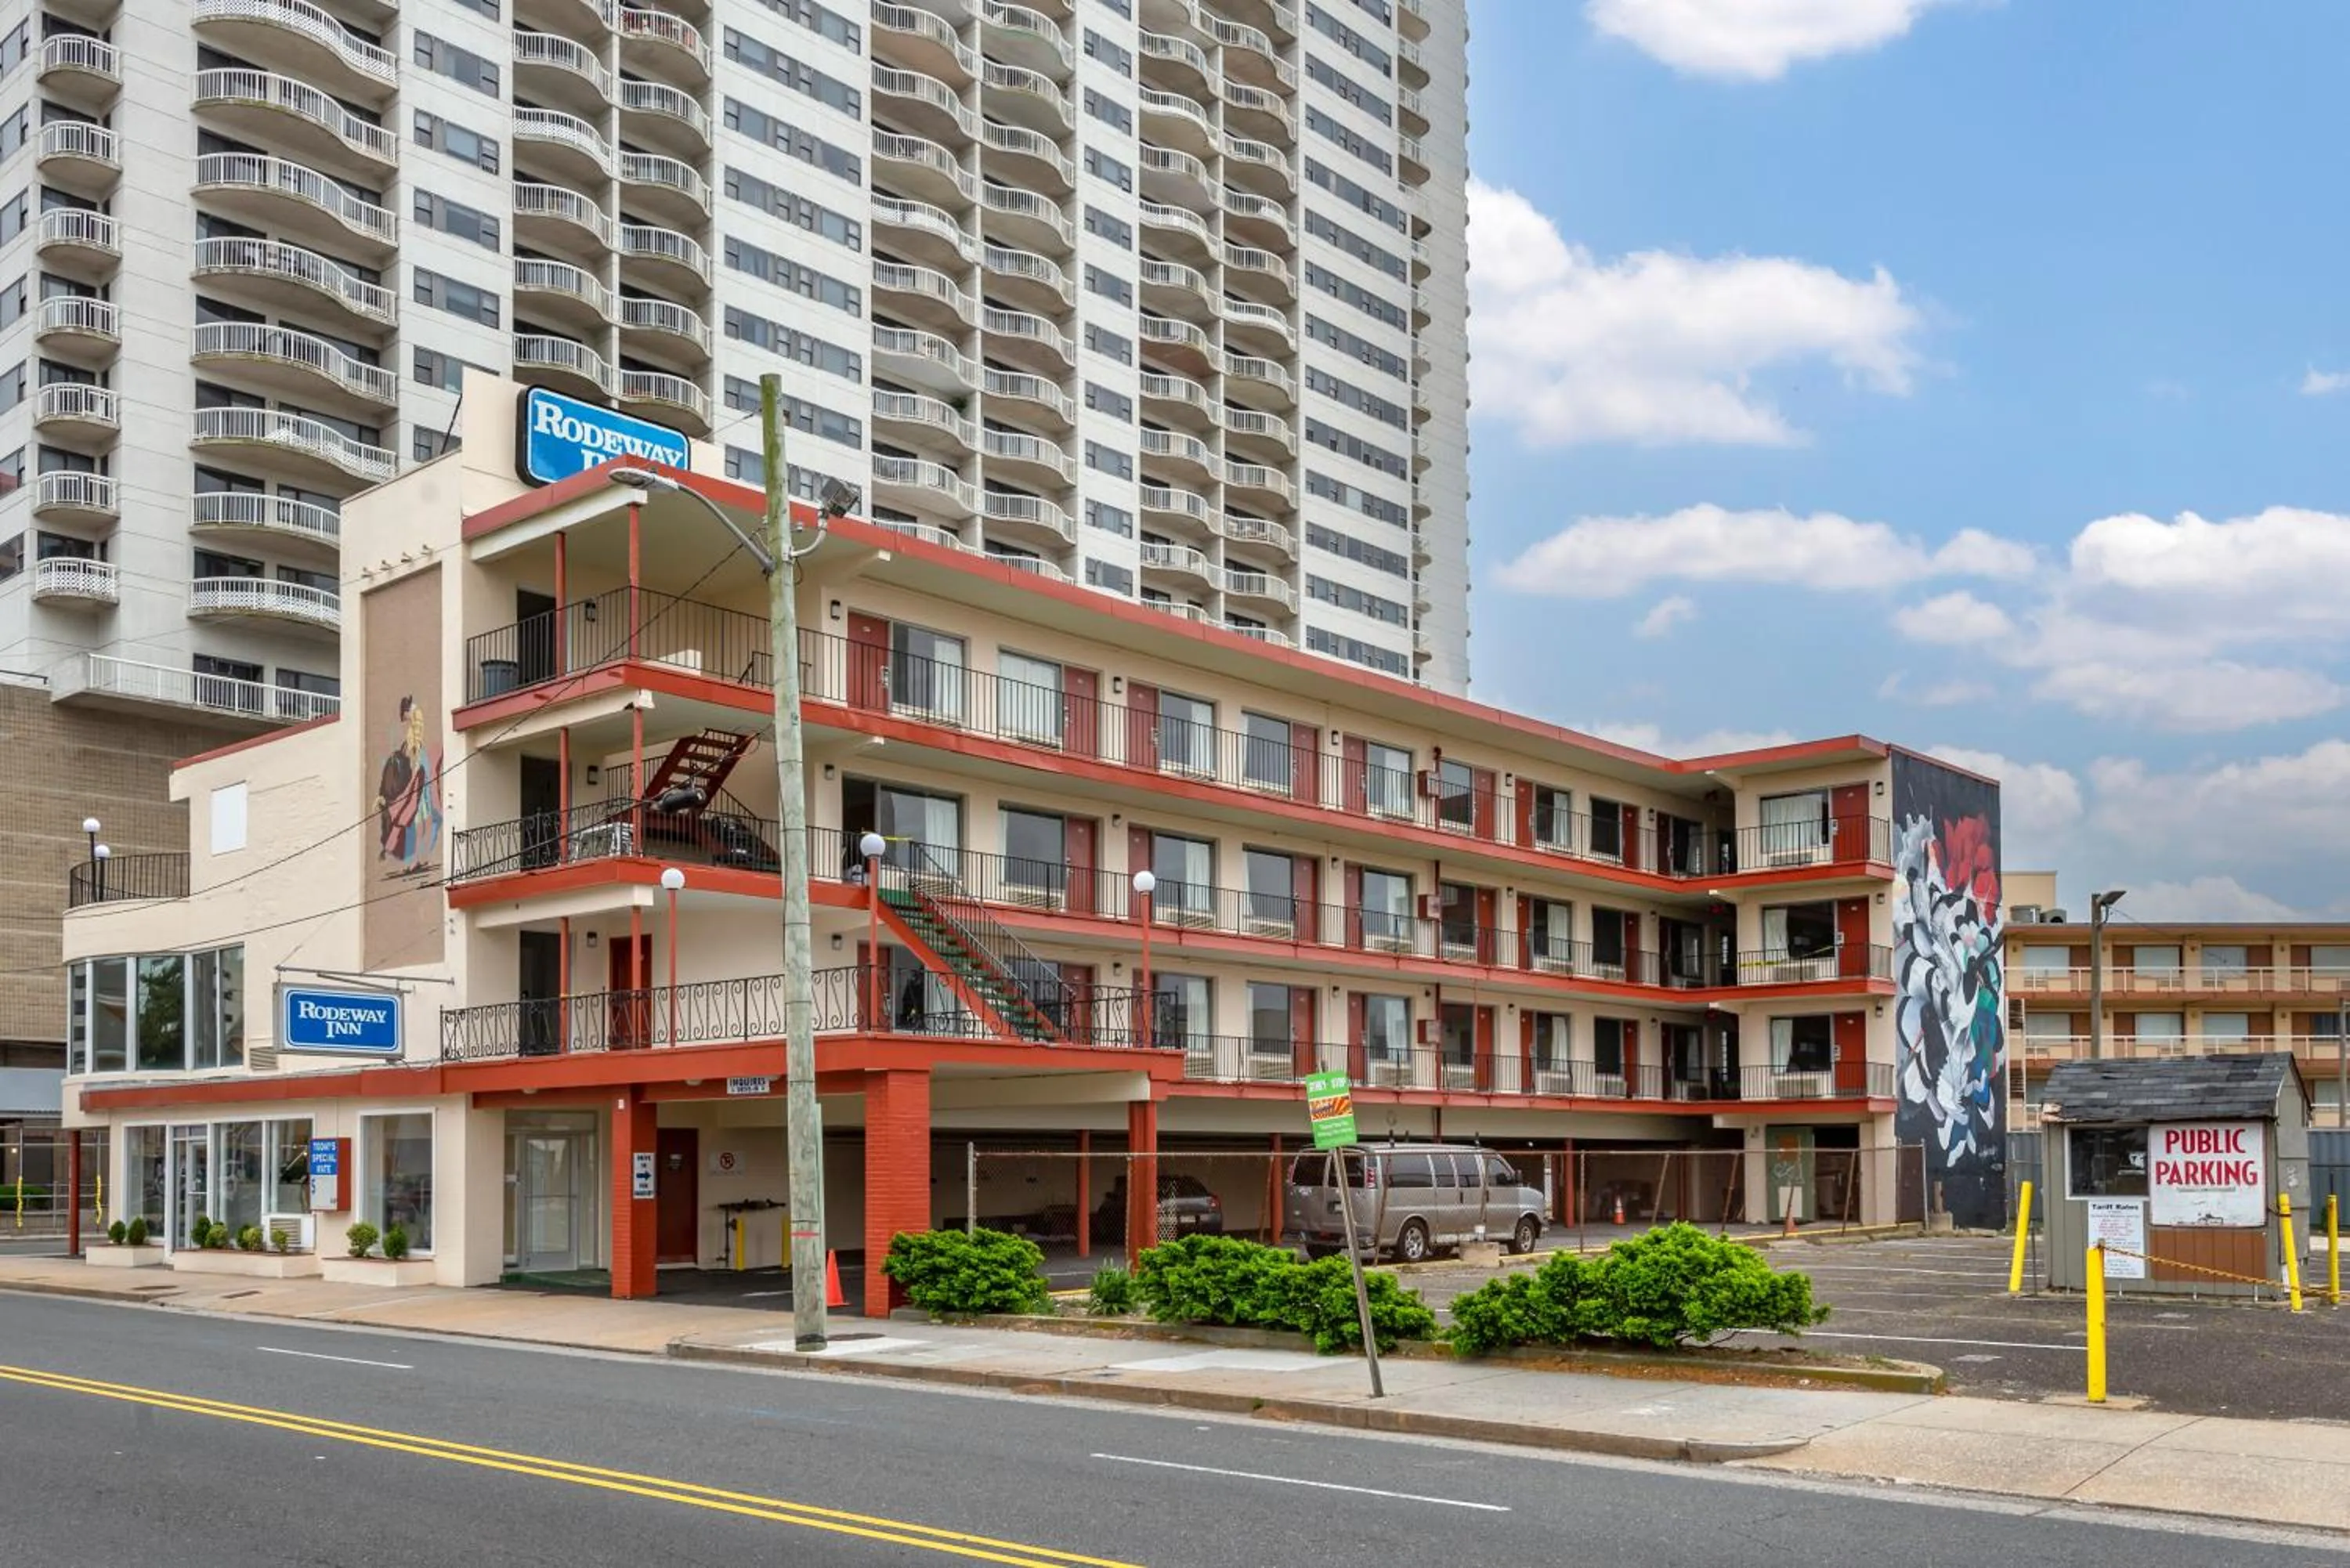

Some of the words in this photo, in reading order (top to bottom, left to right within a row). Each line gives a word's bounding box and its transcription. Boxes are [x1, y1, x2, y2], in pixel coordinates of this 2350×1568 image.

[533, 399, 684, 468] RODEWAY
[298, 1000, 387, 1024] RODEWAY
[326, 1021, 362, 1038] INN
[2165, 1129, 2246, 1154] PUBLIC
[312, 1153, 336, 1163] SPECIAL
[2155, 1159, 2258, 1186] PARKING
